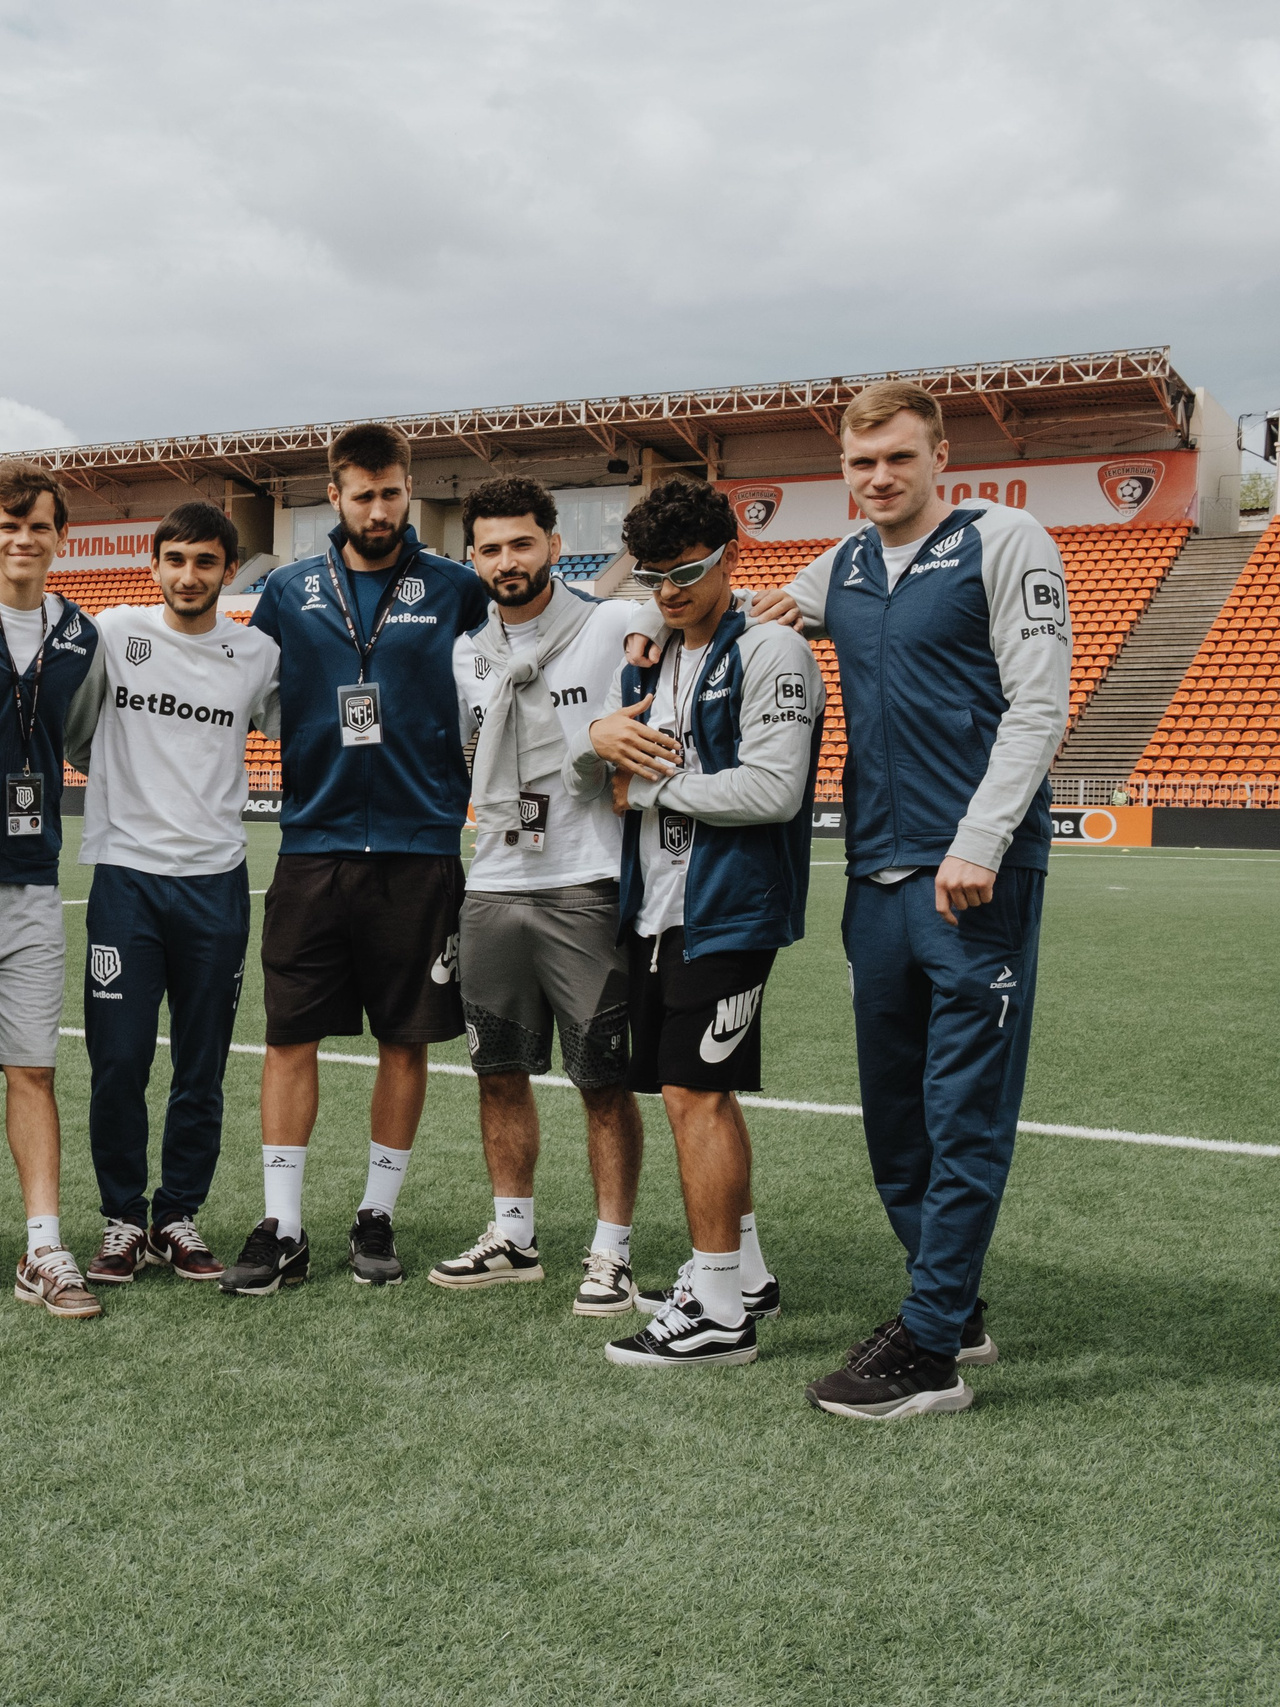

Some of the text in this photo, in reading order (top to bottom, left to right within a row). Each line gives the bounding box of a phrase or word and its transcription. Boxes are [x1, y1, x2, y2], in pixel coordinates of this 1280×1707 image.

[304, 574, 320, 593] 25
[1033, 584, 1061, 610] BB
[301, 603, 328, 611] DEMIX
[782, 683, 804, 699] BB
[115, 686, 234, 728] BetBoom
[989, 981, 1018, 989] DEMIX
[371, 1160, 402, 1172] DEMIX
